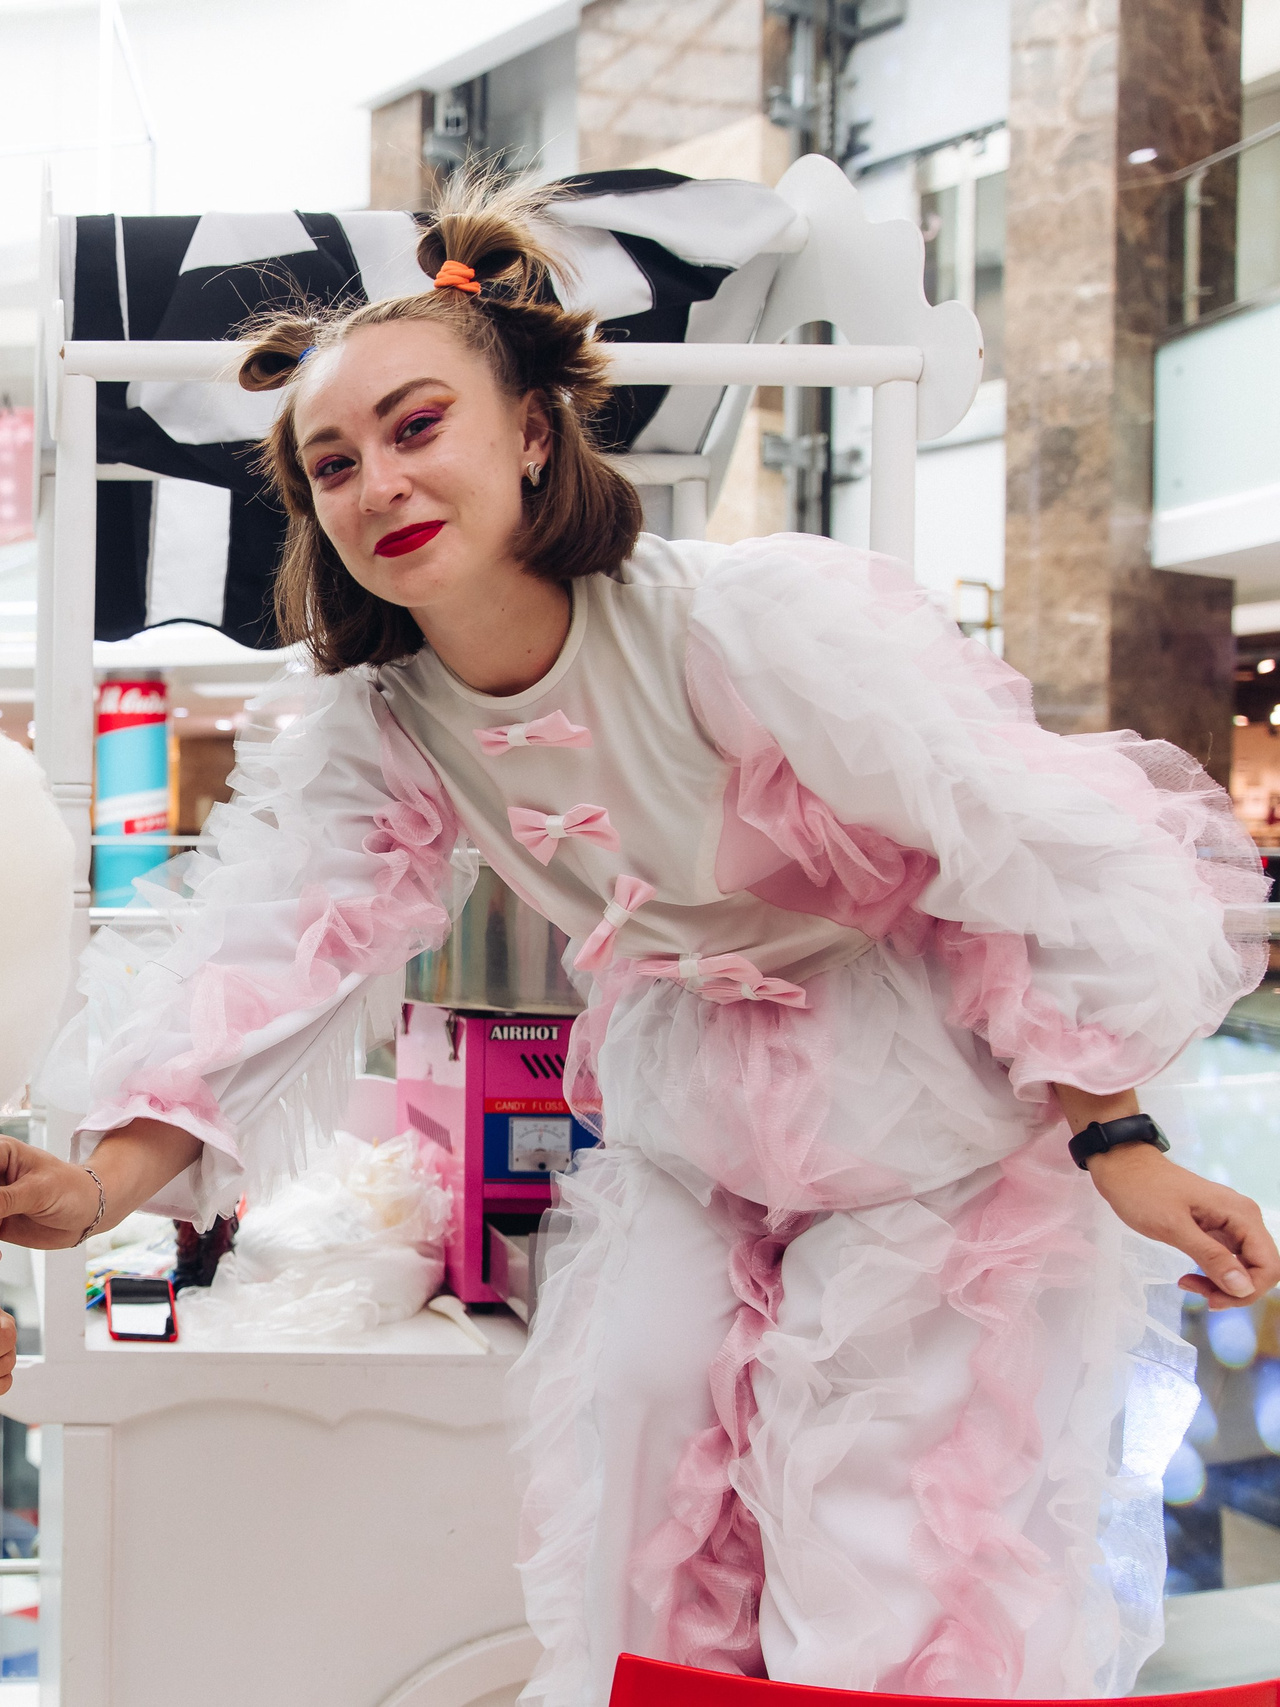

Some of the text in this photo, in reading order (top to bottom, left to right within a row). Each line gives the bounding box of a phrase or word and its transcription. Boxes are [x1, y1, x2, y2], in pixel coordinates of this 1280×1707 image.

[490, 1025, 561, 1041] AIRHOT
[494, 1101, 526, 1111] CANDY
[532, 1101, 564, 1111] FLOSS
